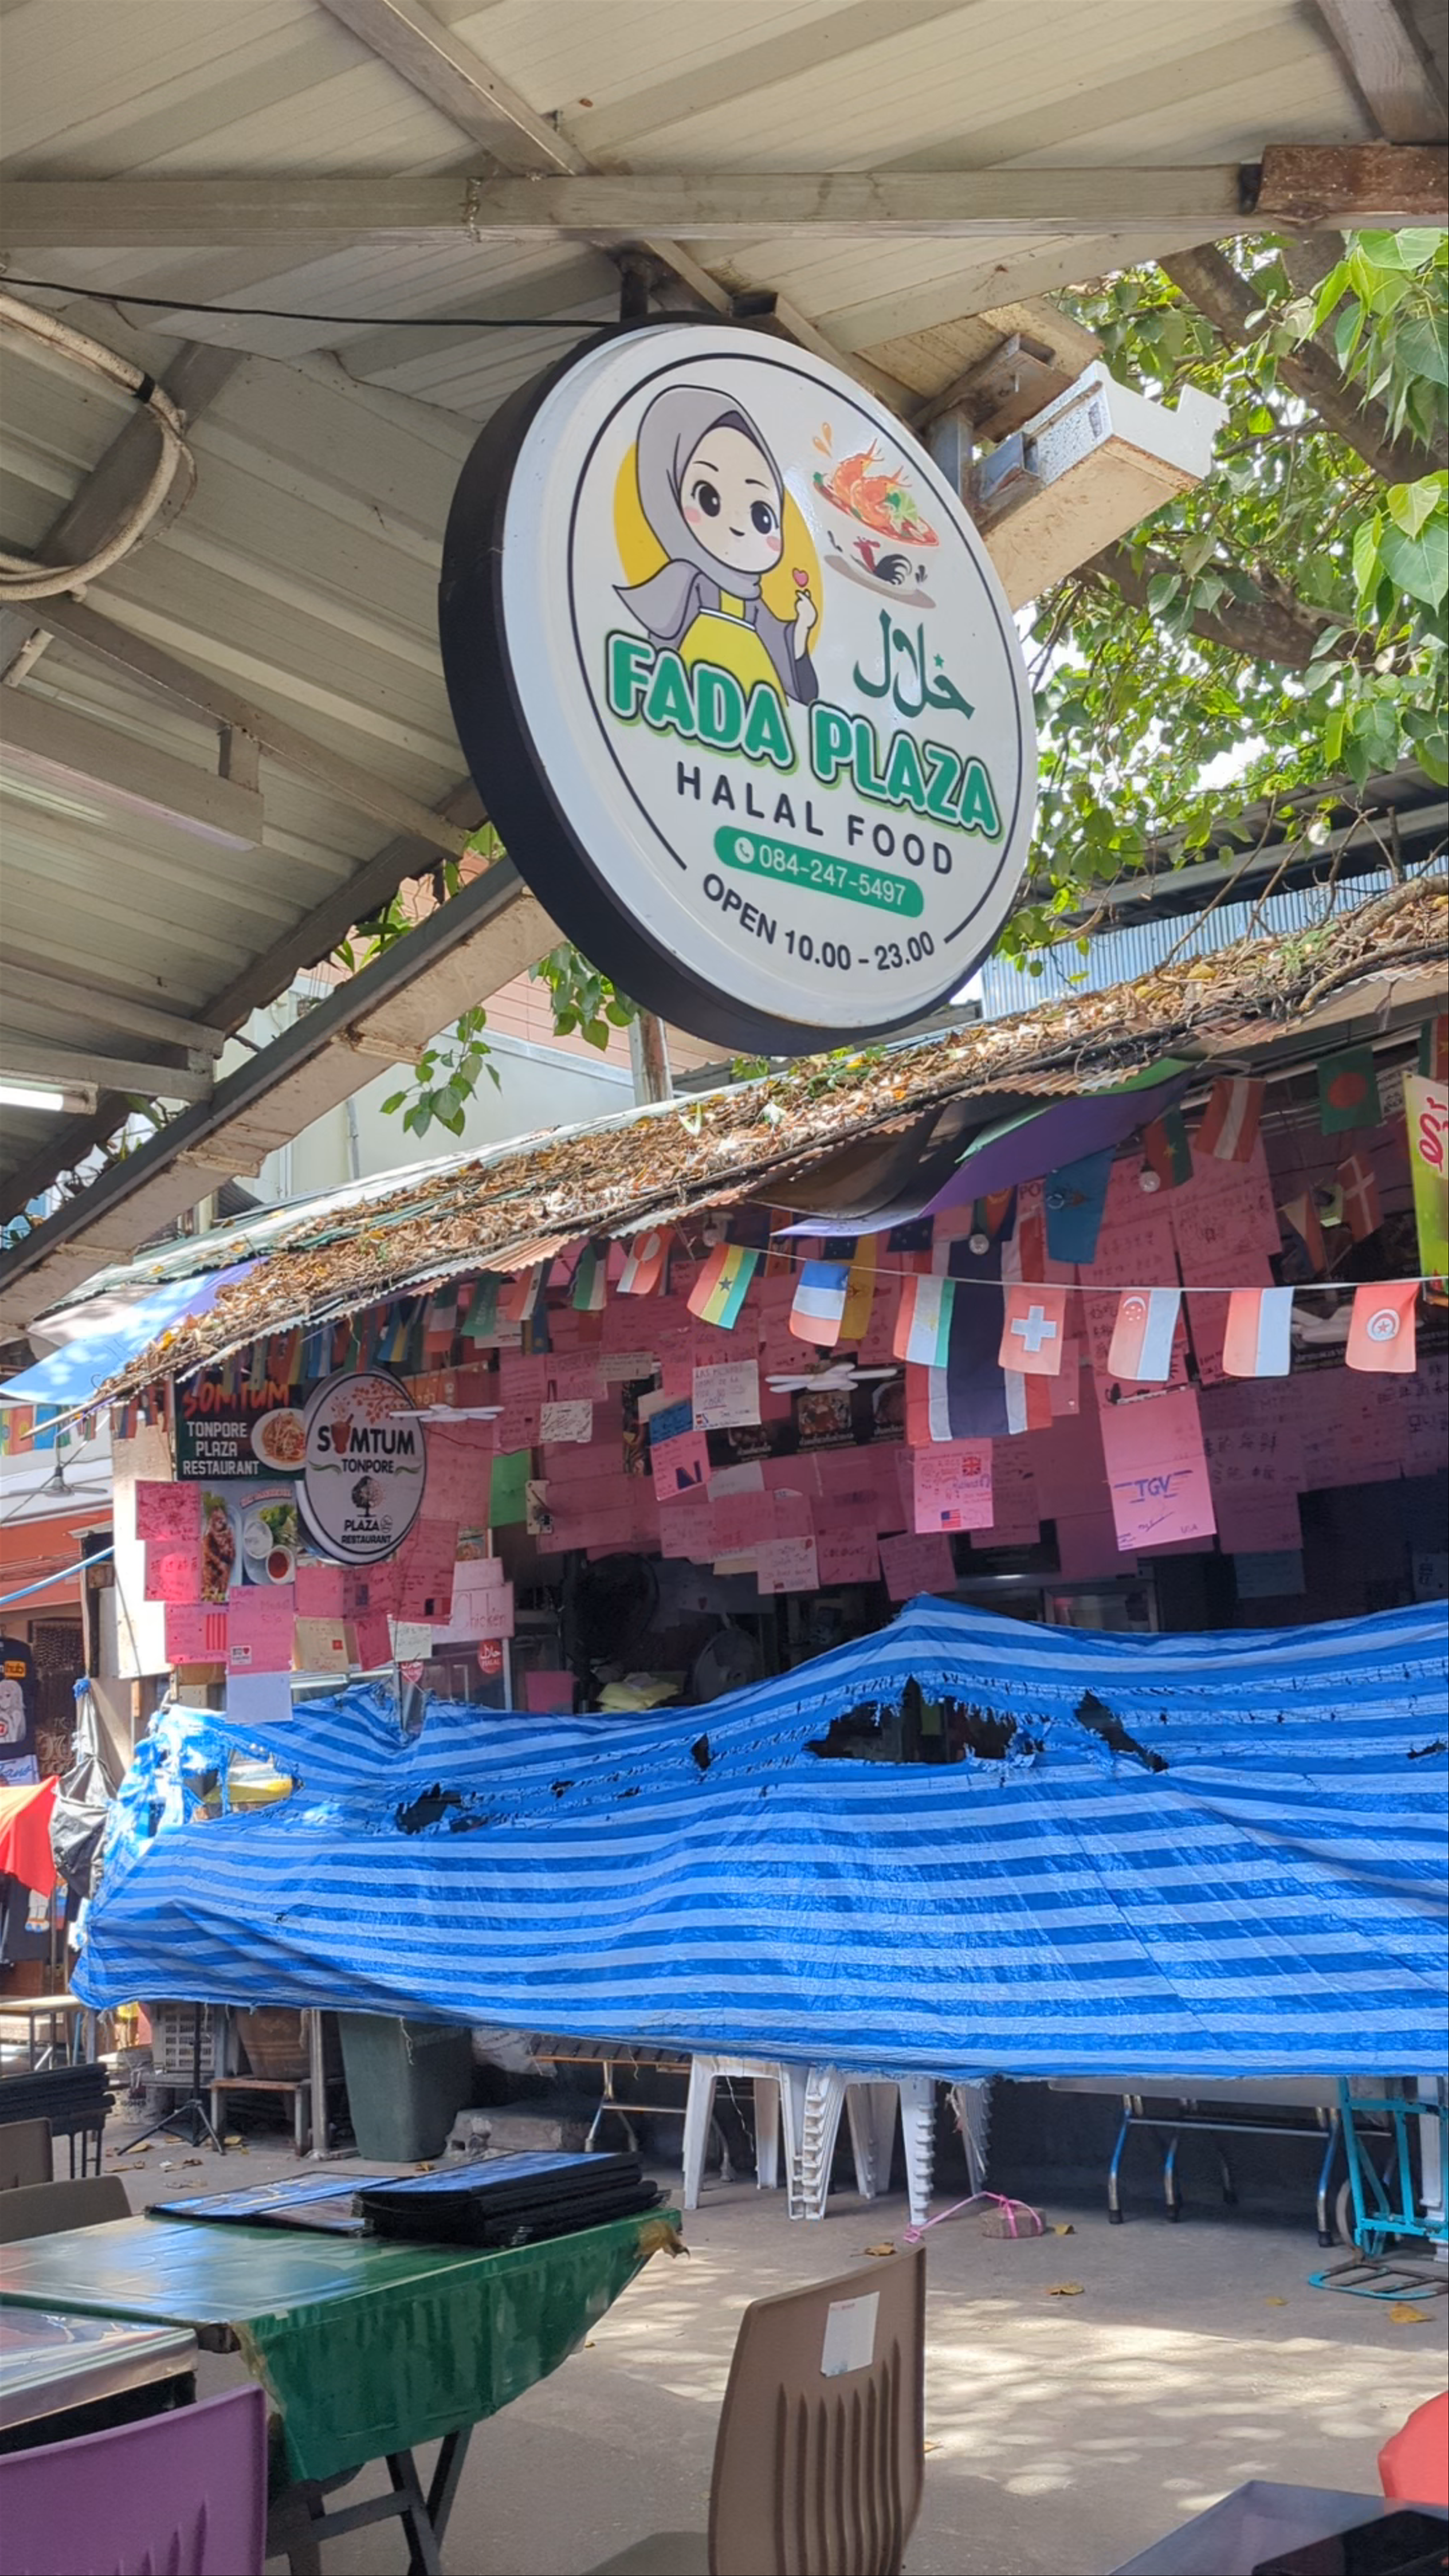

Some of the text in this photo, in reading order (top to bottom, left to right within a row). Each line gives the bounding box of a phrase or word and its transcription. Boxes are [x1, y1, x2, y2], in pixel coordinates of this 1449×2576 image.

[606, 629, 1003, 841] FADA PLAZA
[677, 761, 953, 875] HALAL FOOD
[759, 844, 906, 906] 084-247-5497
[703, 874, 777, 944] OPEN
[784, 929, 851, 970] 10.00
[875, 930, 935, 971] 23.00
[186, 1421, 248, 1437] TONPORE
[195, 1441, 238, 1457] PLAZA
[183, 1460, 259, 1475] RESTAURANT
[341, 1459, 394, 1473] TONPORE
[1134, 1474, 1171, 1497] TGV
[344, 1519, 380, 1531] PLAZA
[341, 1535, 392, 1544] RESTAURANT
